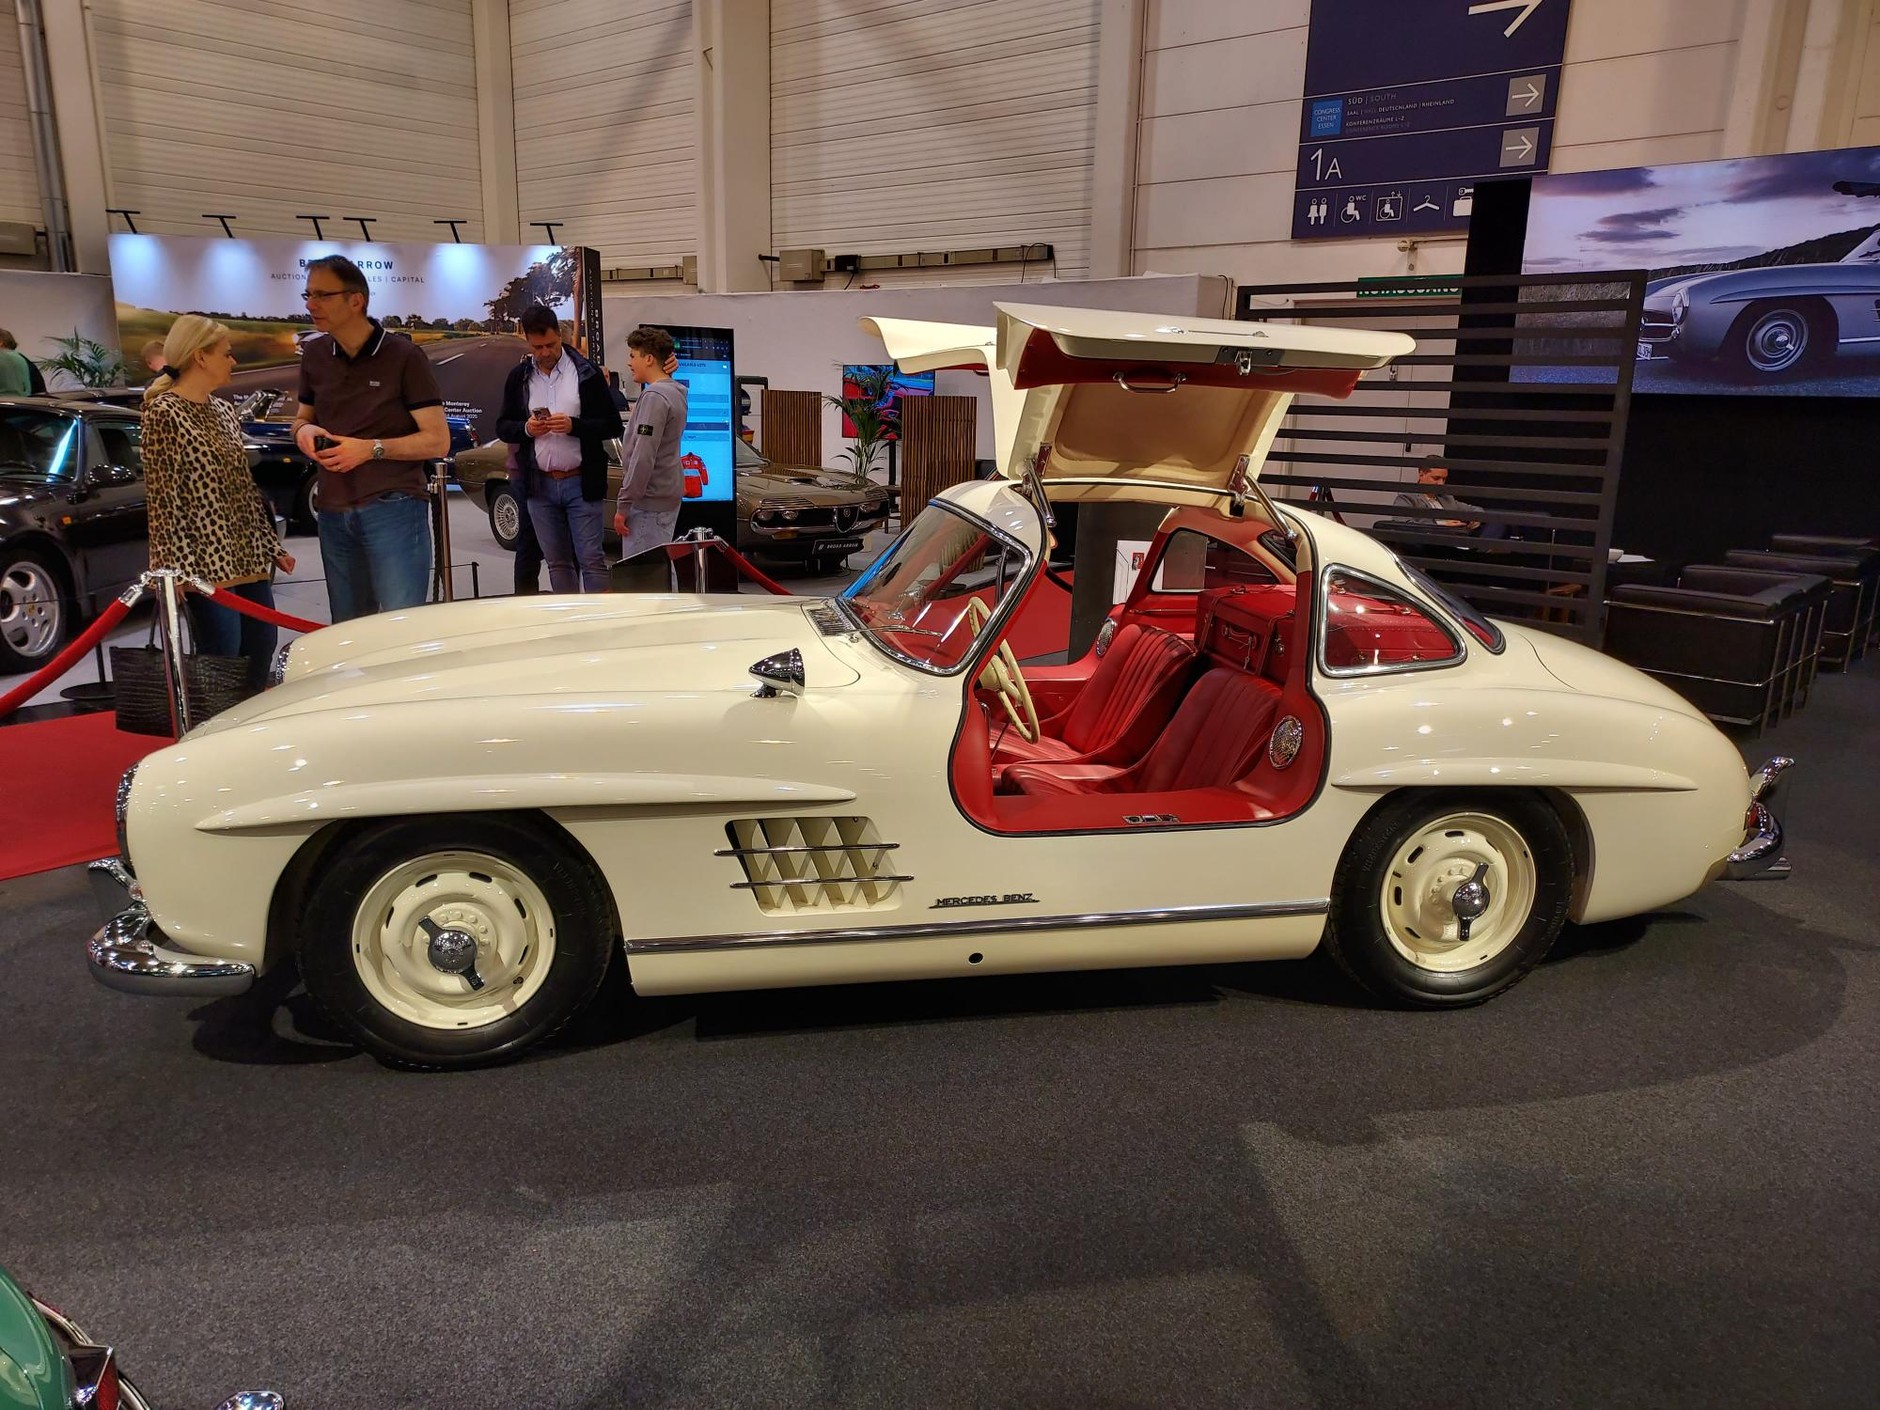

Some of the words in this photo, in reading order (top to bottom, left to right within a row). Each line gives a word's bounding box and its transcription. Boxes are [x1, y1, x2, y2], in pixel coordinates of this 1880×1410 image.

[1347, 97, 1363, 106] SÜD
[1378, 103, 1418, 113] DEUTSCHLAND
[1421, 99, 1455, 108] RHEINLAND
[1314, 107, 1341, 116] CONGRESS
[1316, 115, 1337, 123] CENTER
[1318, 122, 1335, 130] ESSEN
[1310, 148, 1342, 181] 1A
[350, 259, 394, 270] RROW
[270, 273, 307, 281] AUCTION
[368, 275, 382, 283] LES
[391, 276, 425, 284] CAPITAL
[936, 895, 998, 907] MERCEDES
[1003, 893, 1034, 902] BENZ
